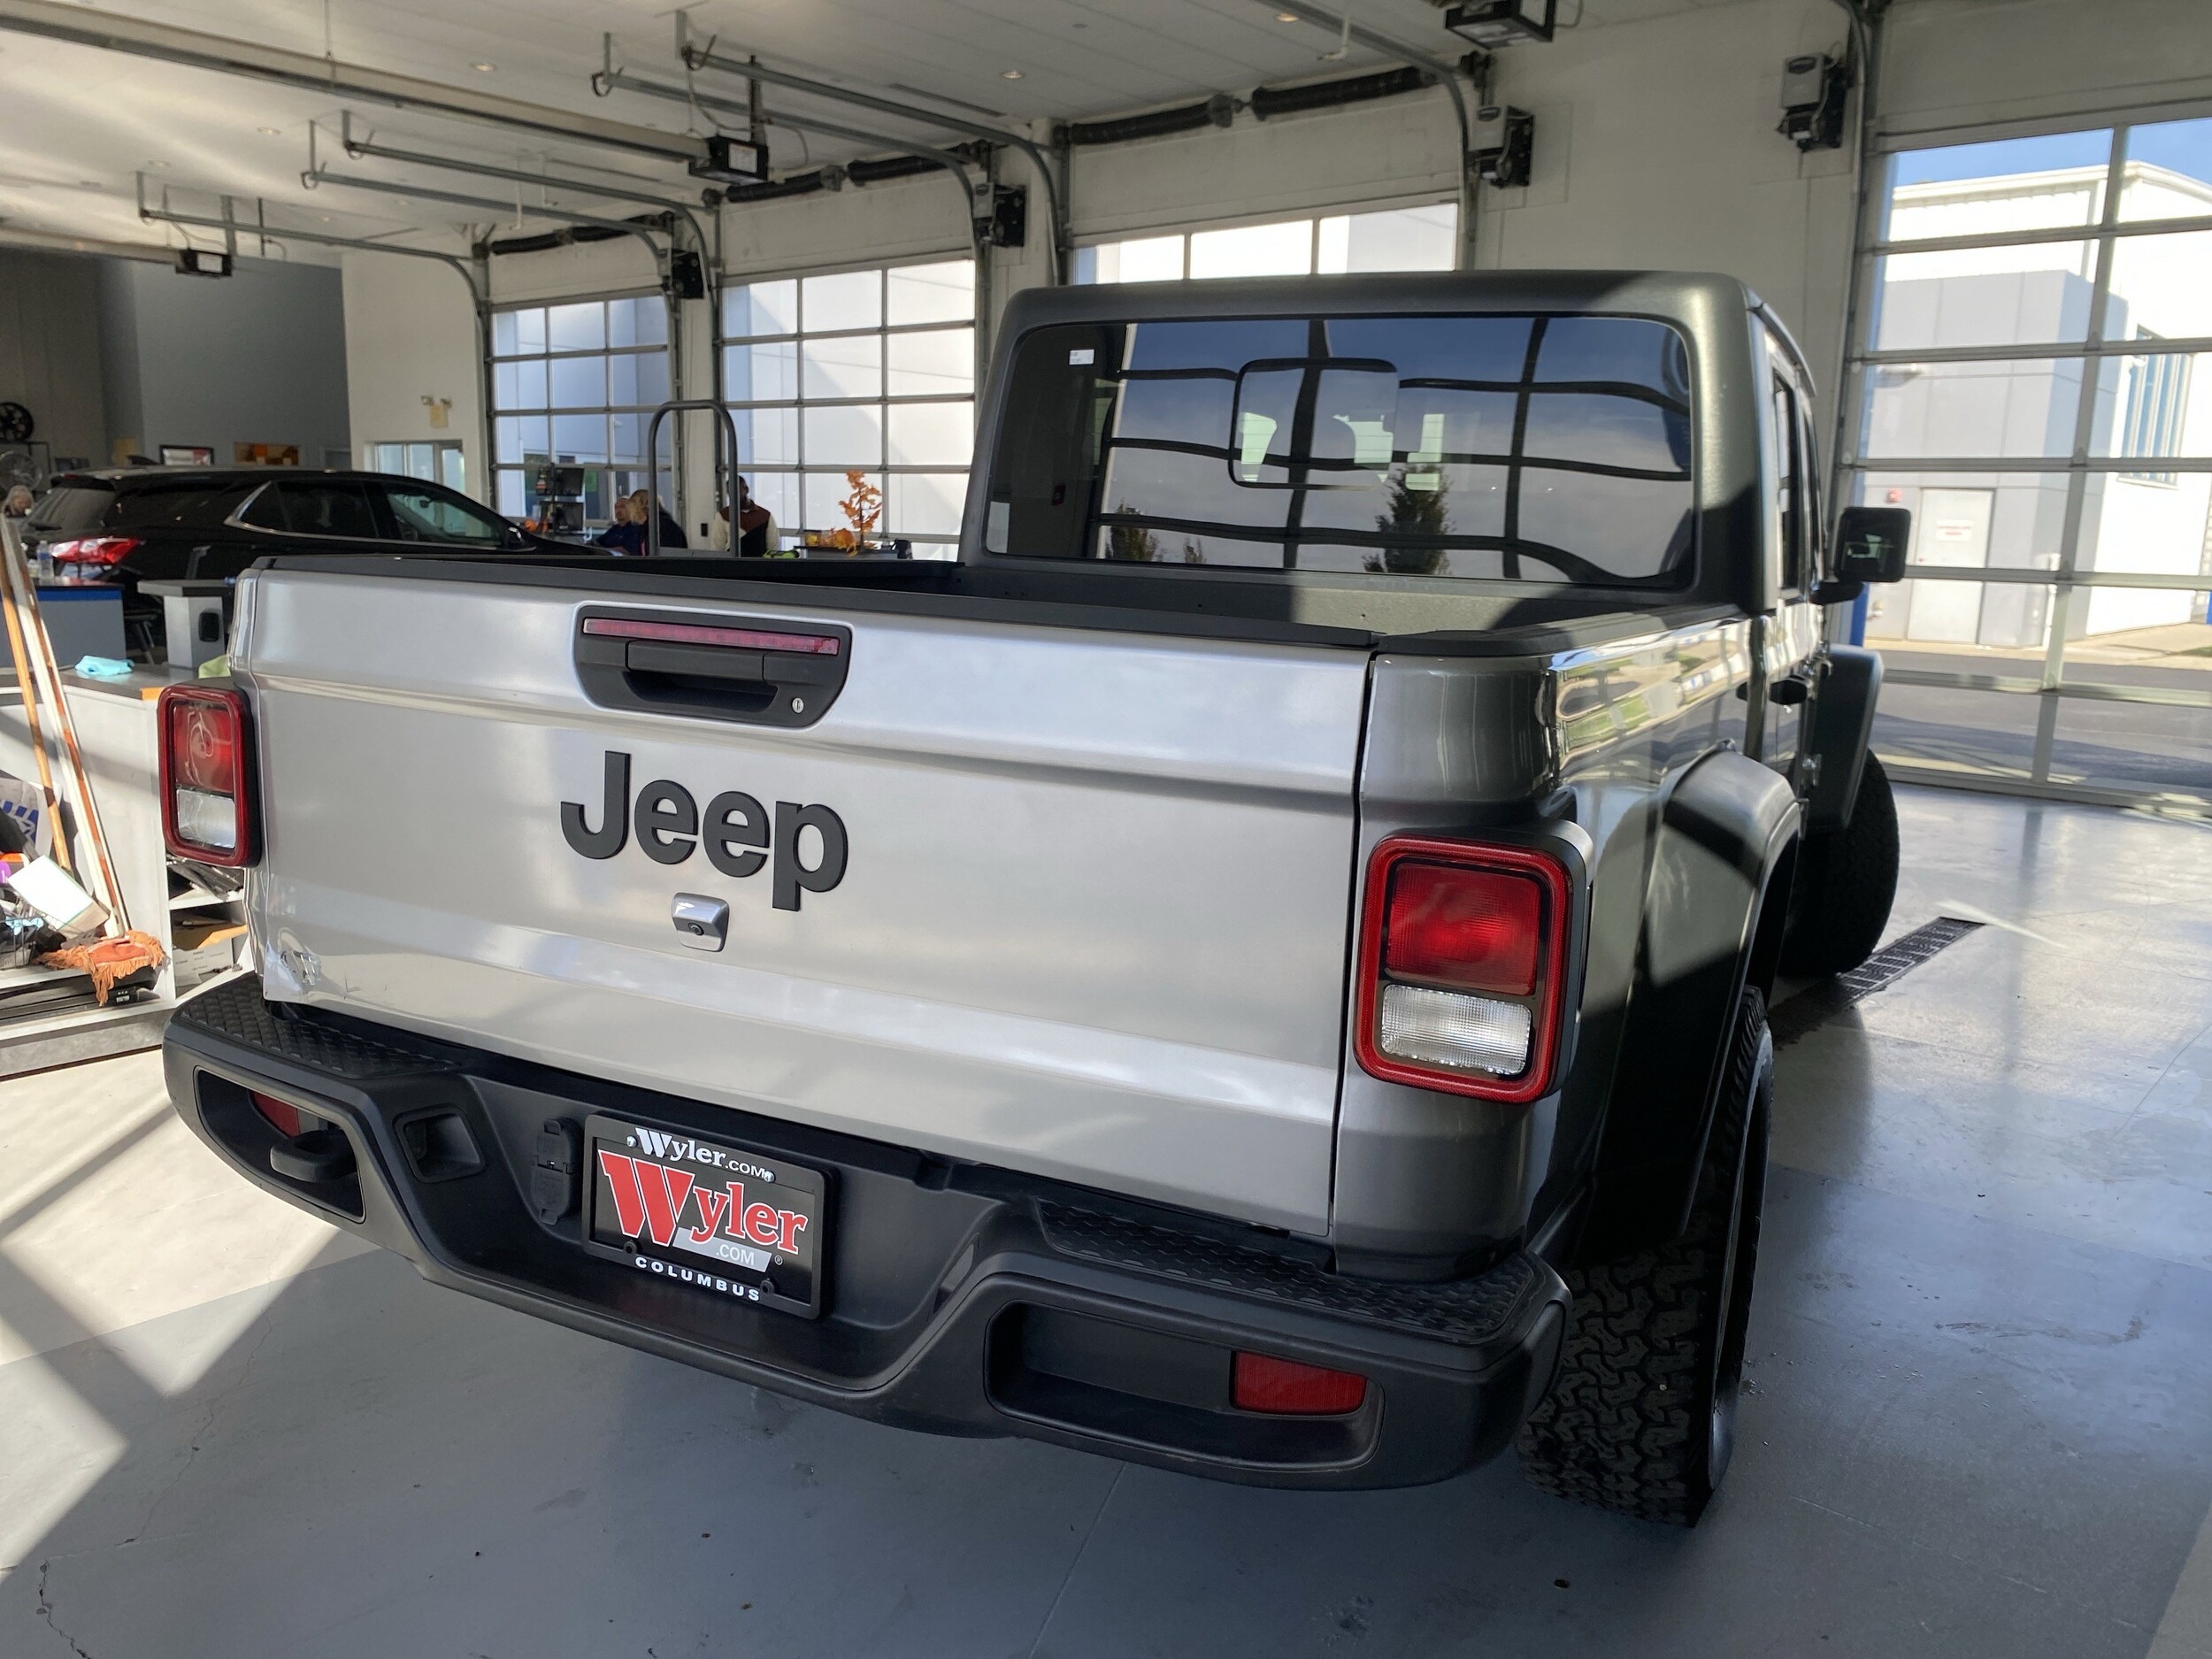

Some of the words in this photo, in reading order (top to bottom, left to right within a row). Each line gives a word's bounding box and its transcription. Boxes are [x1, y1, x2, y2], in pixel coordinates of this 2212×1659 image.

[560, 749, 849, 912] Jeep
[597, 1148, 809, 1256] Wyler
[634, 1256, 760, 1302] COLUMBUS
